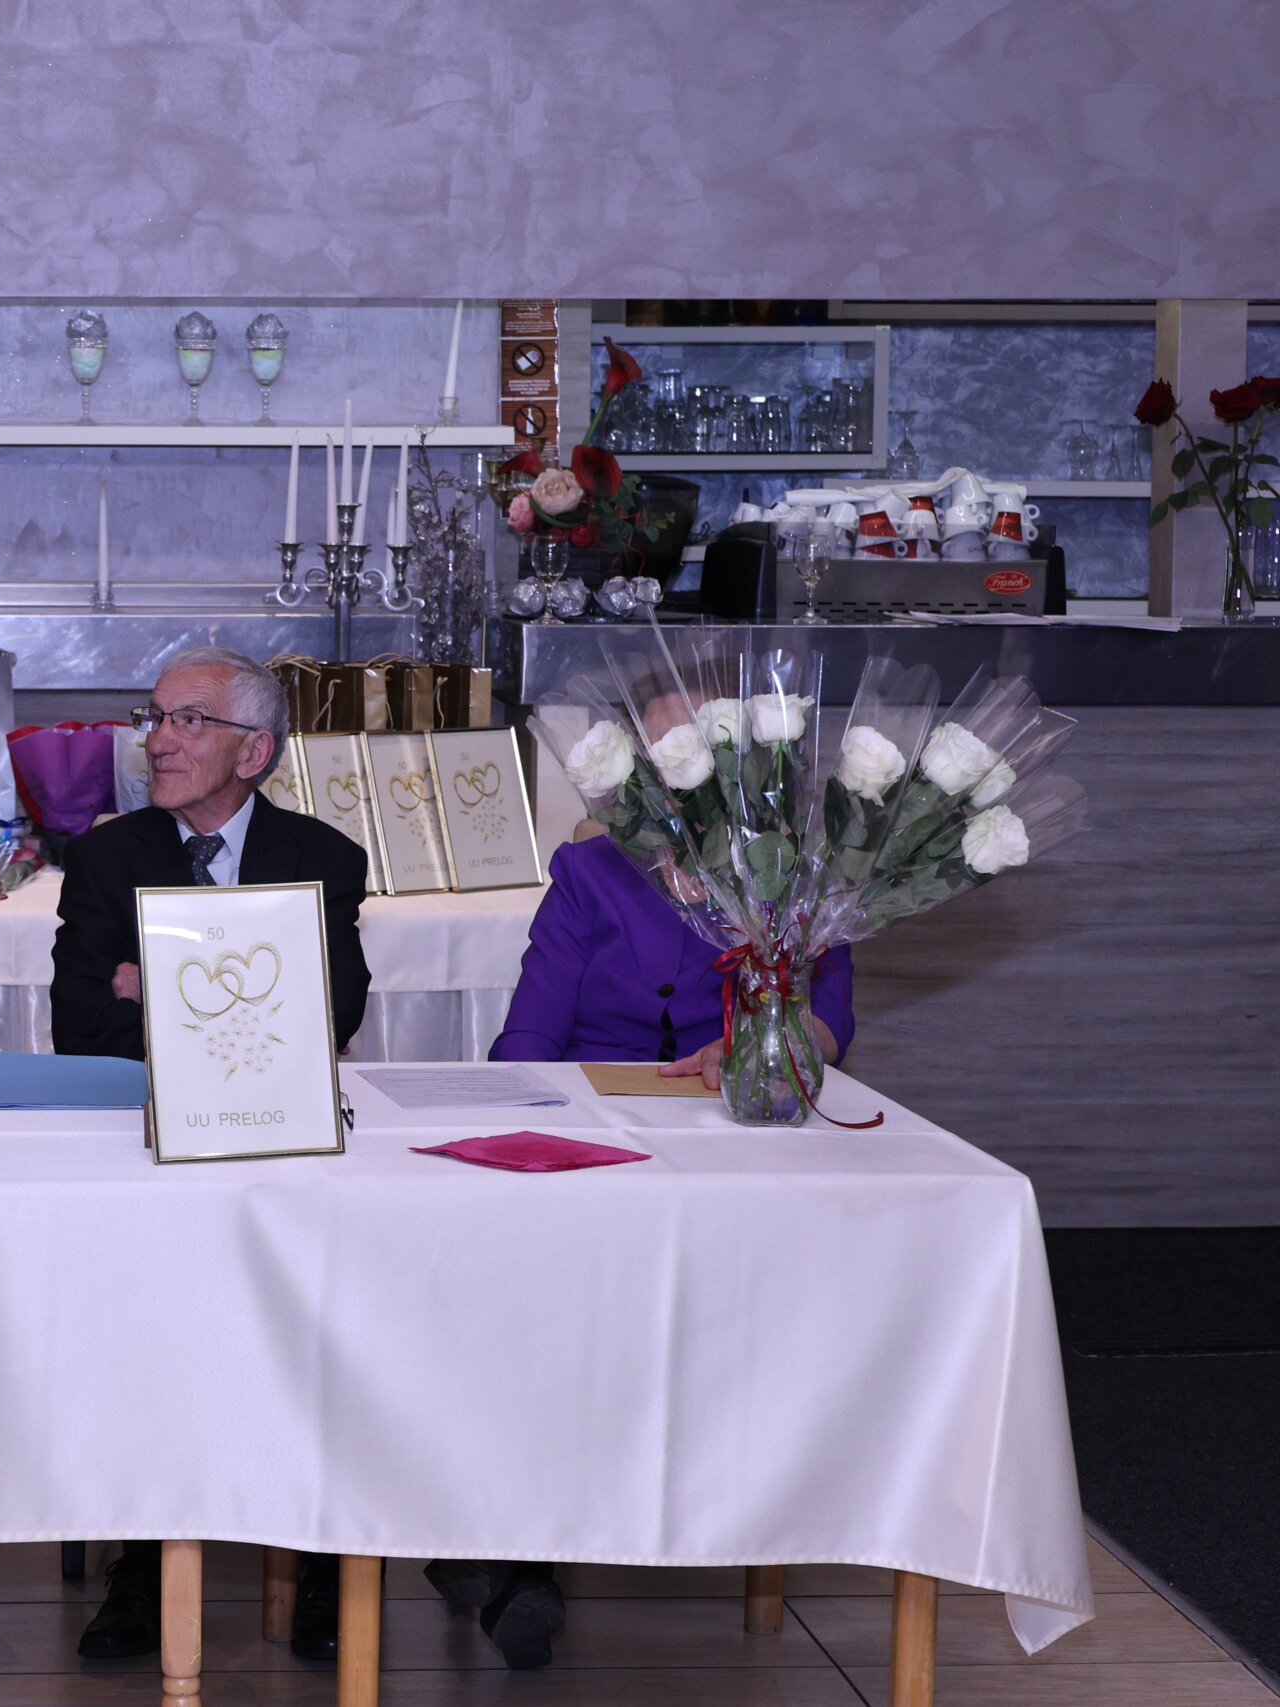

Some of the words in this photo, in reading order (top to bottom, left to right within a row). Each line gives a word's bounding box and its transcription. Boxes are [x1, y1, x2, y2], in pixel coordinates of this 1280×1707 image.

[332, 755, 342, 765] 50
[461, 752, 470, 761] 50
[398, 761, 407, 770] 50
[481, 855, 513, 867] PRELOG
[207, 926, 225, 941] 50
[186, 1113, 210, 1128] UU
[218, 1110, 286, 1127] PRELOG
